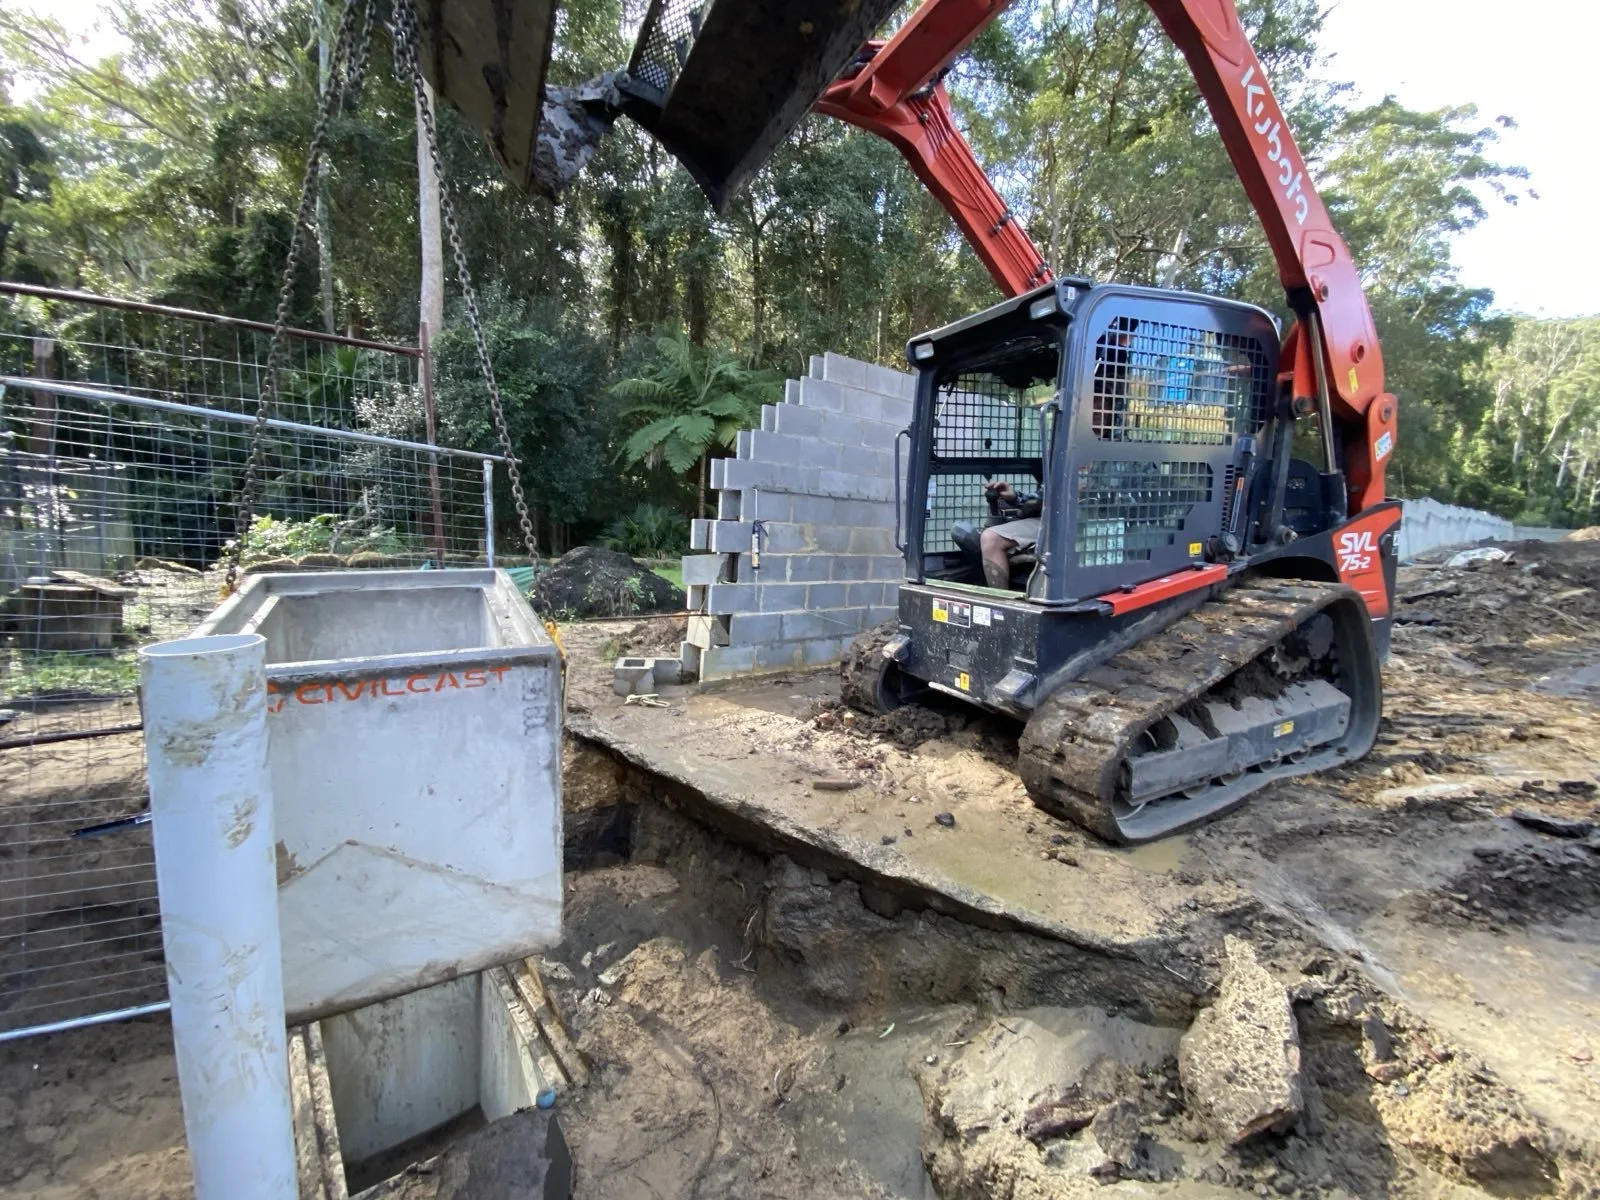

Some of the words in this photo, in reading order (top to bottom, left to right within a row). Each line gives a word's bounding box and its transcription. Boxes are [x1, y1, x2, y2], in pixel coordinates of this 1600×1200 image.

[1241, 66, 1308, 225] Kubota
[1338, 532, 1376, 554] SVL
[1340, 554, 1371, 572] 75-2
[295, 665, 513, 706] CIVILCAST
